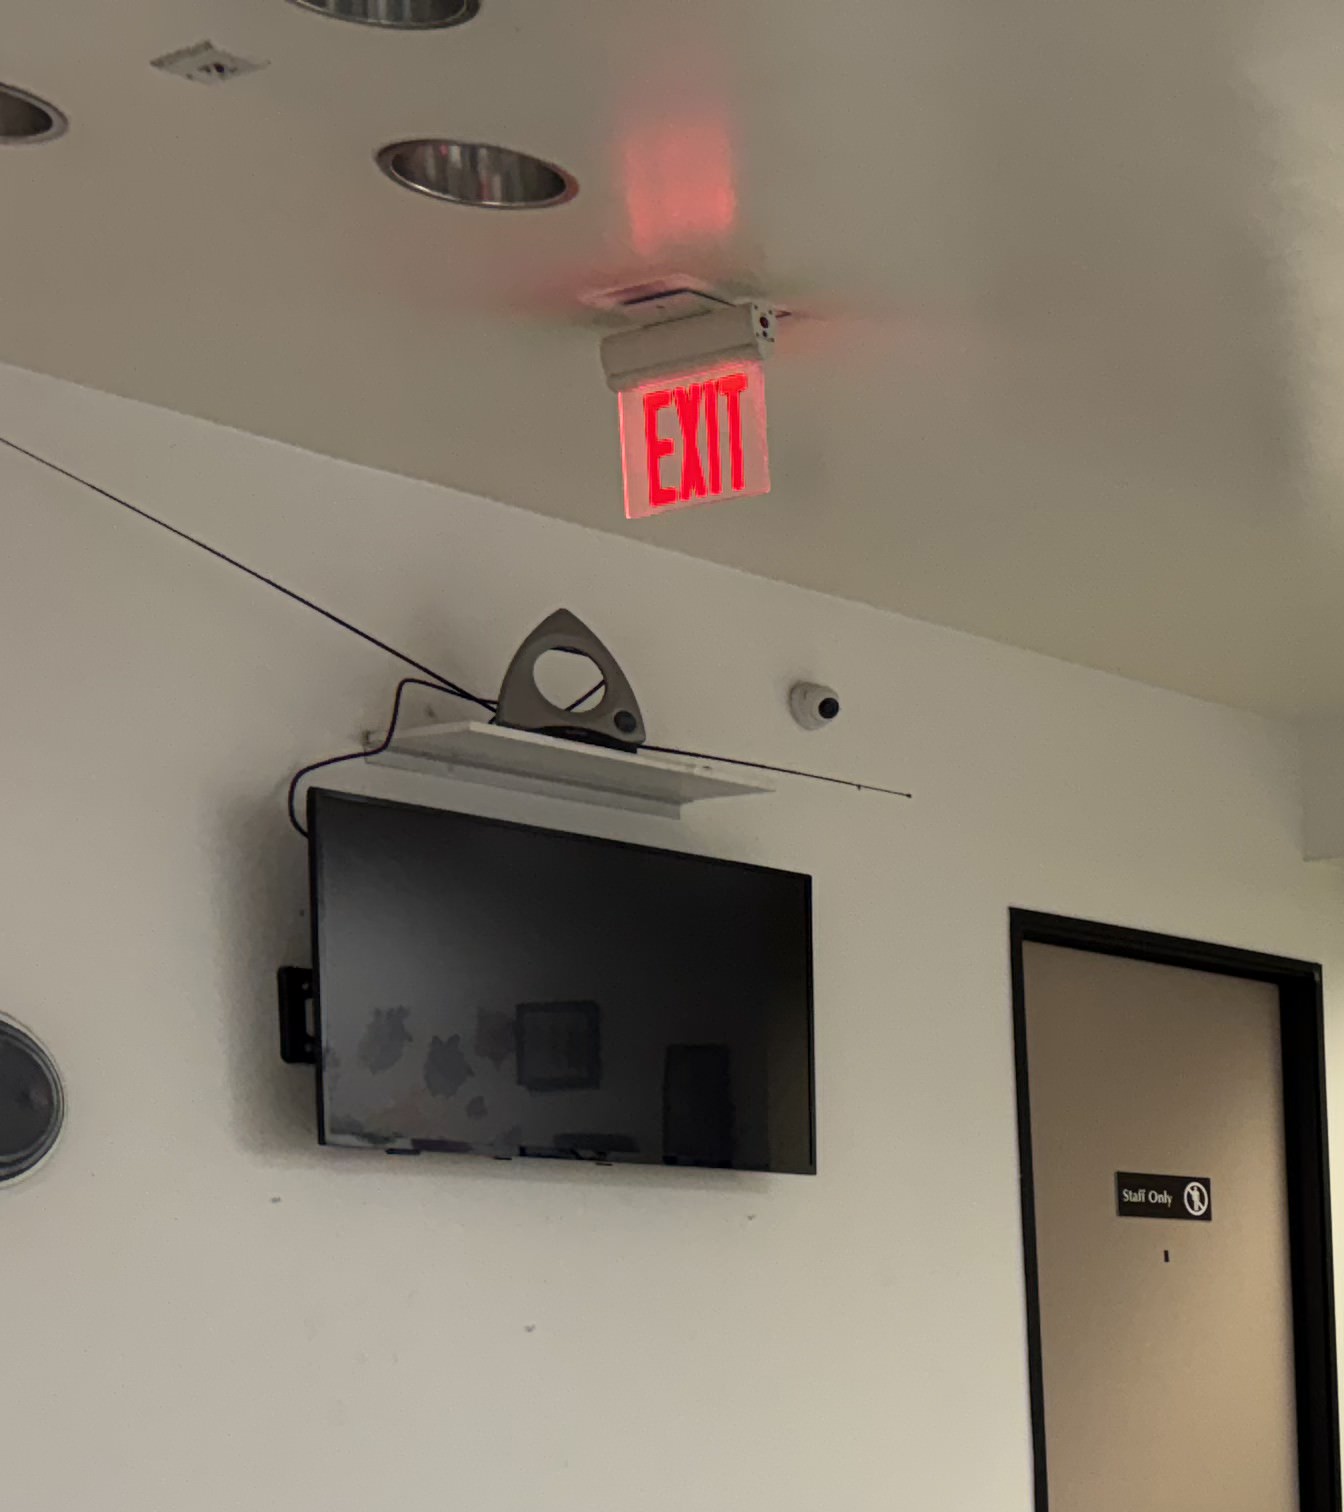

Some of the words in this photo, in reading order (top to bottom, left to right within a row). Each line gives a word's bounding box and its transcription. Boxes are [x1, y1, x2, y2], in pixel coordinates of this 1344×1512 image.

[643, 373, 748, 507] EXIT
[1122, 1189, 1146, 1203] Staff
[1148, 1190, 1173, 1208] Only
